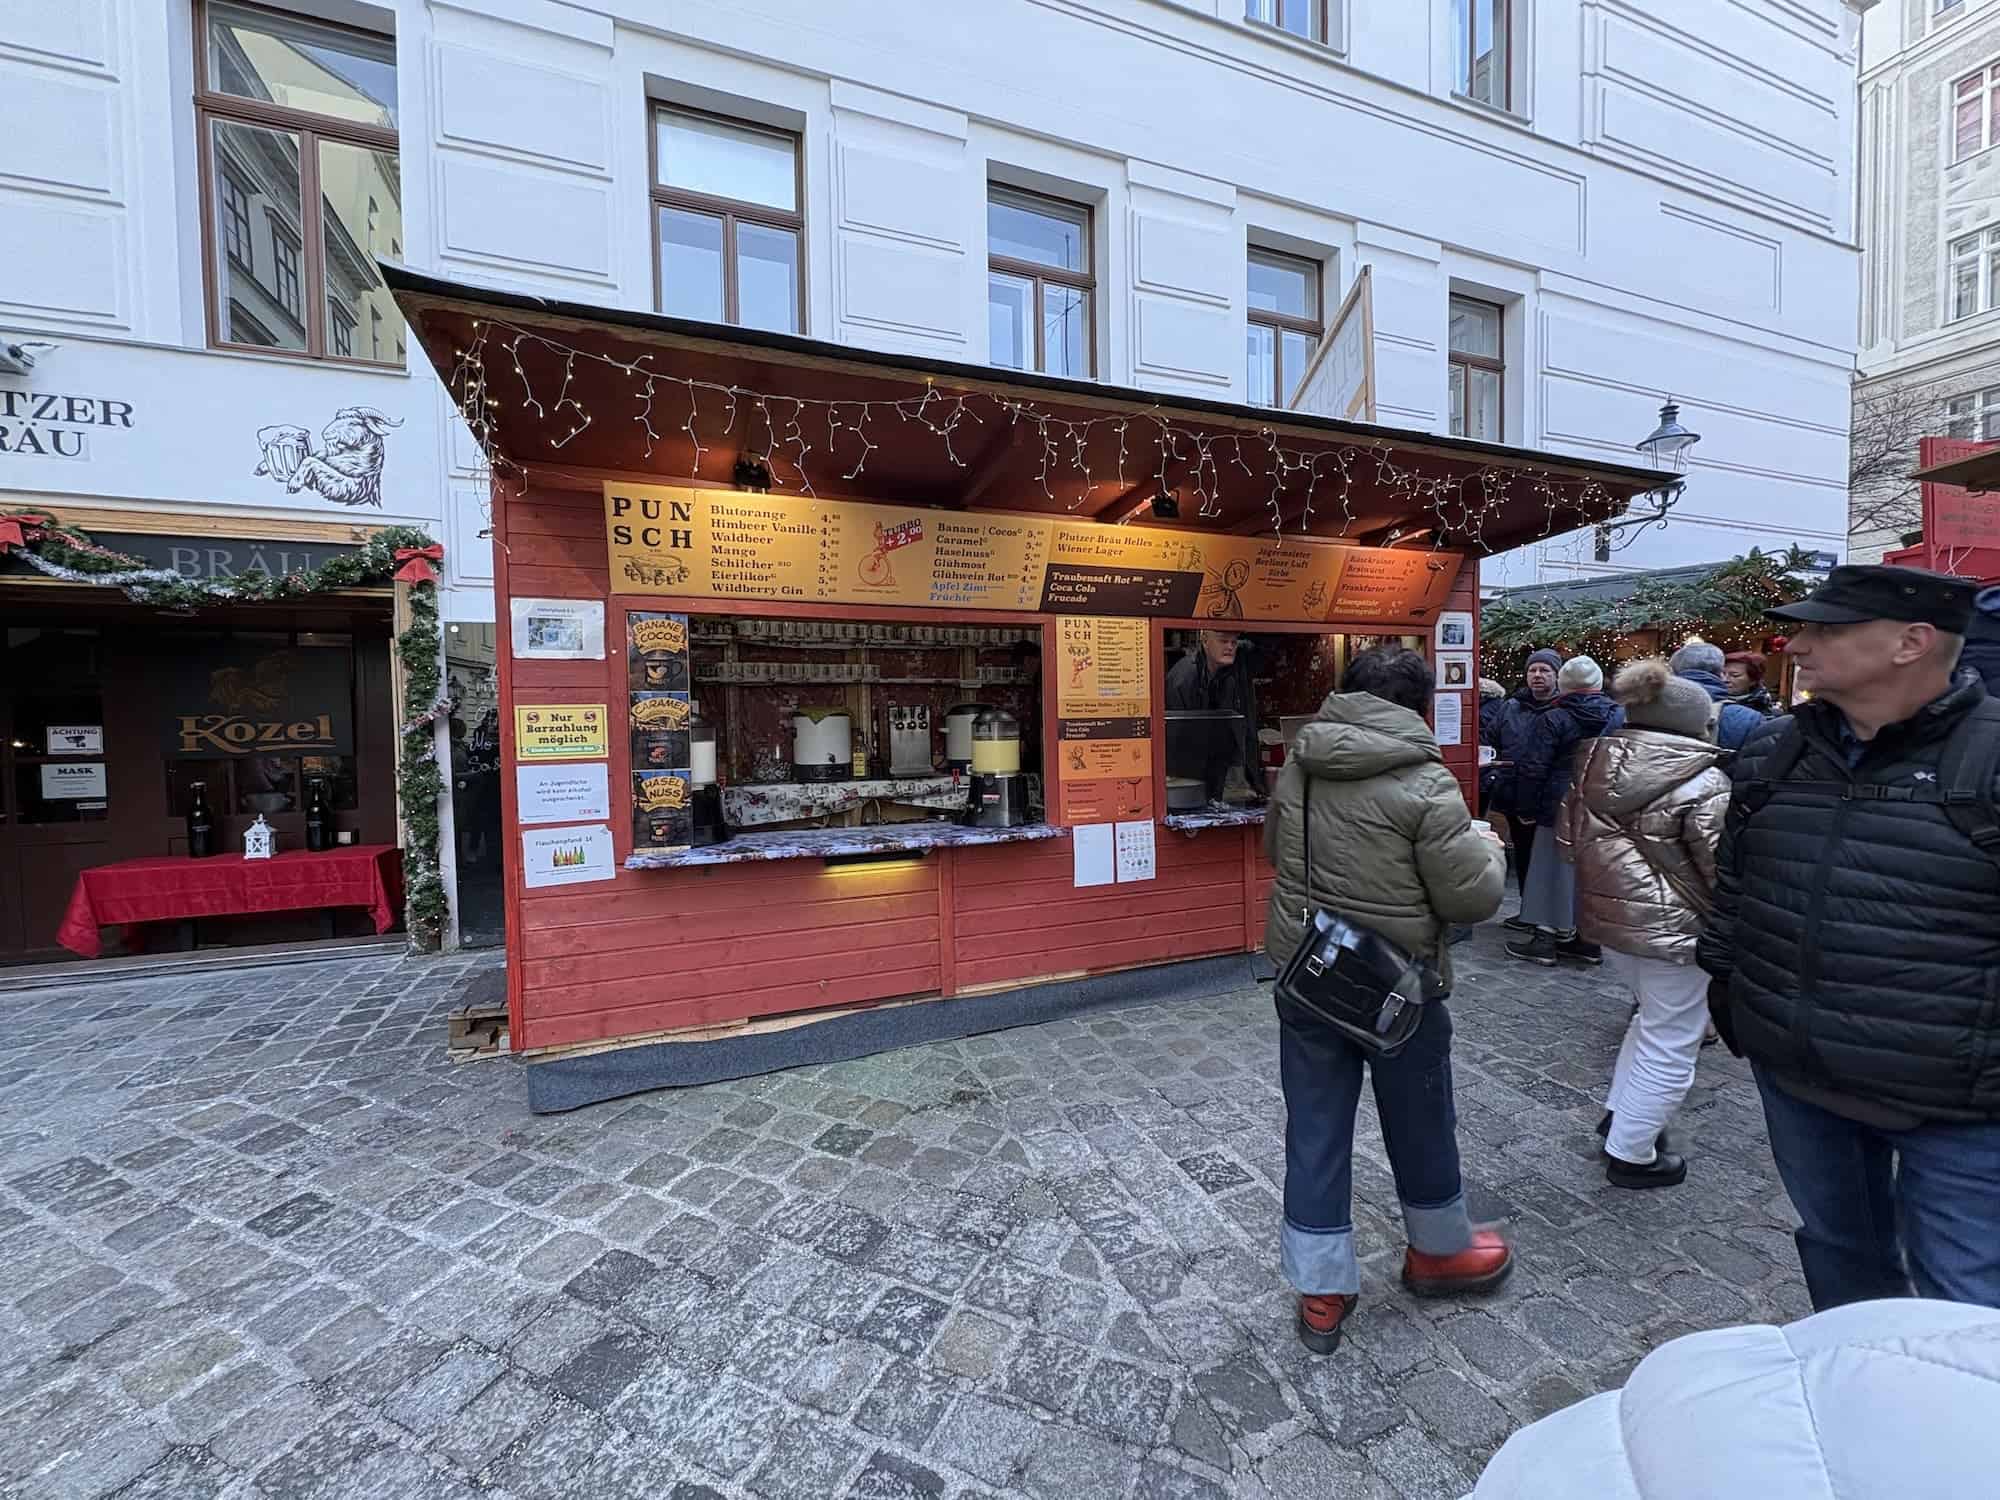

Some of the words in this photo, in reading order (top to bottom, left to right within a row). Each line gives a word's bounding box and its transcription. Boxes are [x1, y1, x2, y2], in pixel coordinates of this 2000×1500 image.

[0, 390, 134, 428] TZER
[611, 496, 692, 522] PUN
[711, 505, 786, 521] Blutorange
[712, 518, 767, 531] Himbeer
[772, 522, 816, 535] Vanille
[884, 518, 921, 536] TURBO
[938, 523, 980, 534] Banane
[988, 526, 1018, 536] Cocos
[614, 525, 692, 549] SCH
[712, 532, 774, 544] Waldbeer
[936, 535, 982, 546] Caramel
[1124, 537, 1152, 547] Helles
[712, 545, 756, 558] Mango
[936, 546, 990, 558] Haselnuss
[1057, 544, 1092, 554] Wiener
[1096, 546, 1124, 556] Lager
[712, 558, 774, 570] Schilcher
[988, 572, 1006, 582] Rot
[1052, 572, 1112, 583] Traubensaft
[1114, 575, 1130, 584] Rot
[712, 582, 778, 596] Wildberry
[781, 586, 804, 595] Gin
[932, 582, 960, 592] Apfel
[963, 583, 987, 592] Zimt
[1050, 582, 1073, 592] Coca
[1075, 584, 1096, 593] Cola
[636, 620, 682, 634] BANANE
[1064, 619, 1091, 628] PUN
[640, 632, 681, 642] COCOS
[1064, 630, 1091, 640] SCH
[634, 699, 688, 715] CARAMEL
[550, 713, 574, 722] Nur
[52, 728, 98, 736] ACHTUNG
[176, 712, 336, 754] Kozel
[526, 723, 598, 734] Barzahlung
[538, 734, 588, 746] möglich
[58, 767, 94, 775] MASK
[644, 778, 681, 790] HASEL
[649, 788, 681, 800] NUSS
